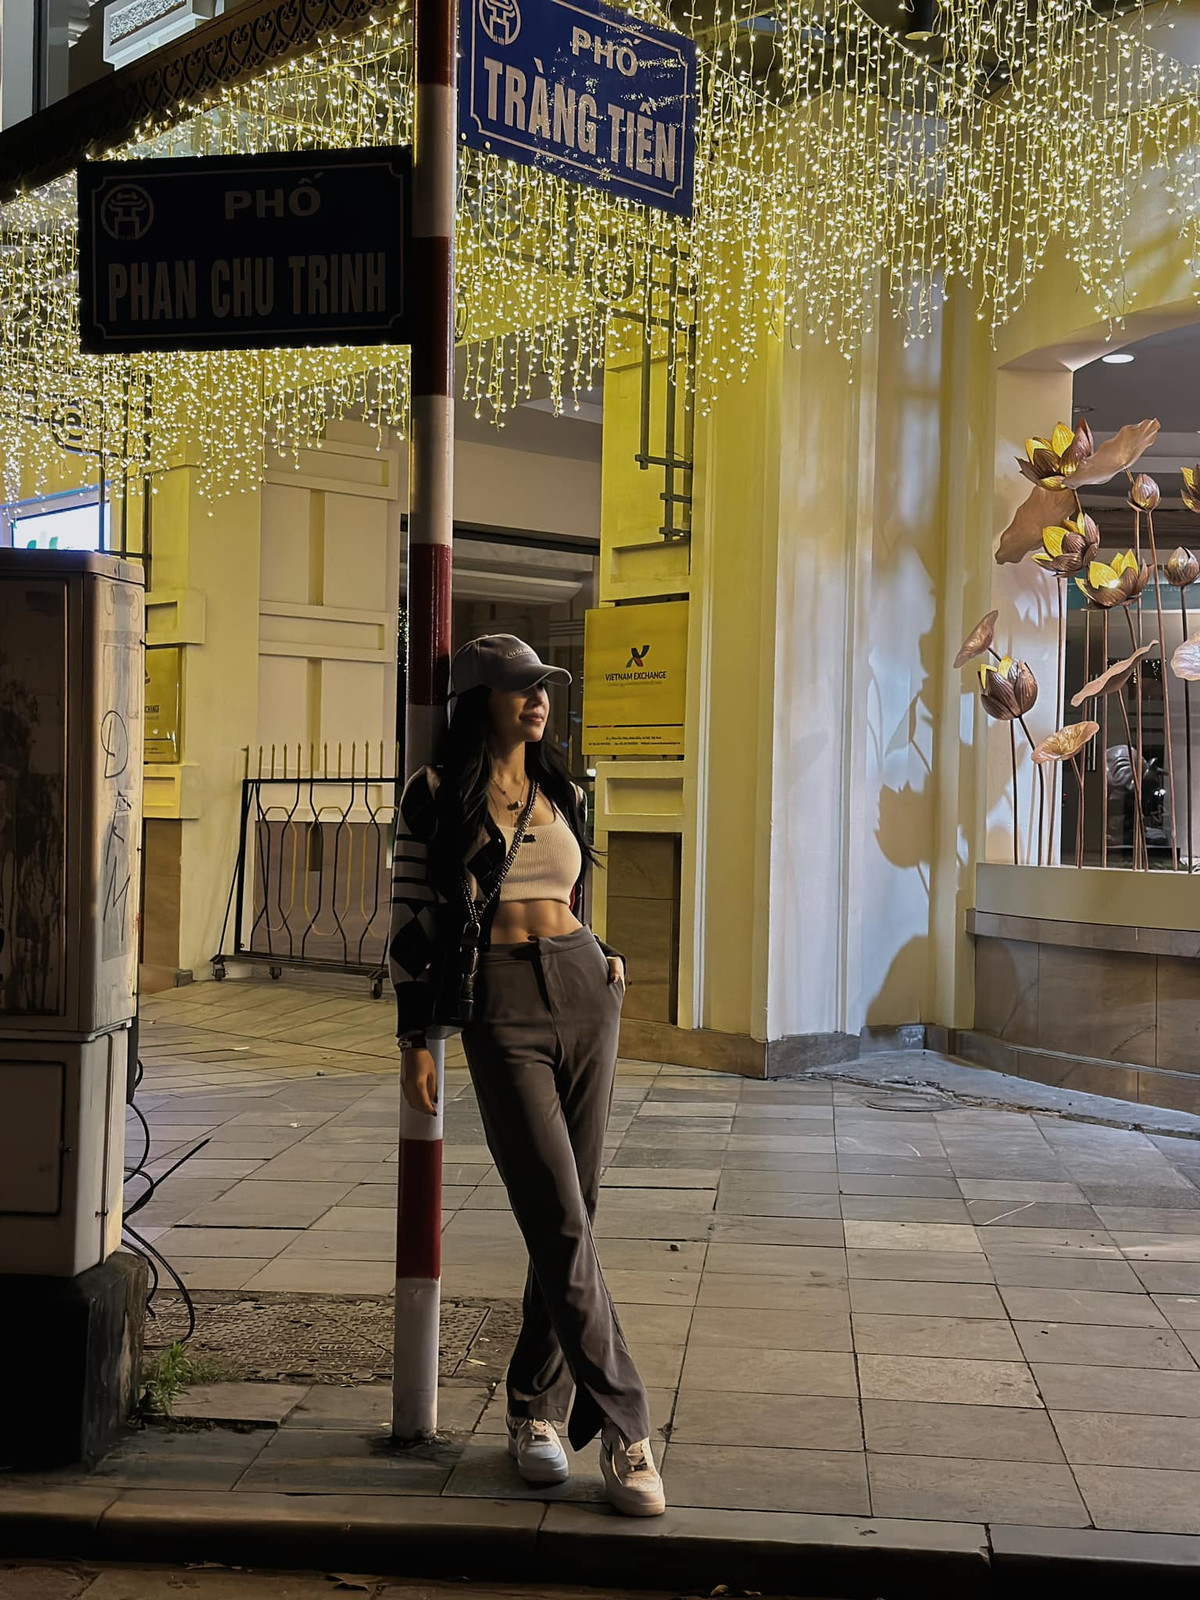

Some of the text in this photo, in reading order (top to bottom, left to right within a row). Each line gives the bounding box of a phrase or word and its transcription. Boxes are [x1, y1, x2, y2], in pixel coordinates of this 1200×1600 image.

[571, 26, 641, 77] PHỐ
[483, 57, 597, 155] TRÀNG
[225, 172, 324, 219] PHỐ
[108, 252, 386, 322] PHAN CHU TRINH
[606, 671, 666, 681] VIETNAM EXCHANGE
